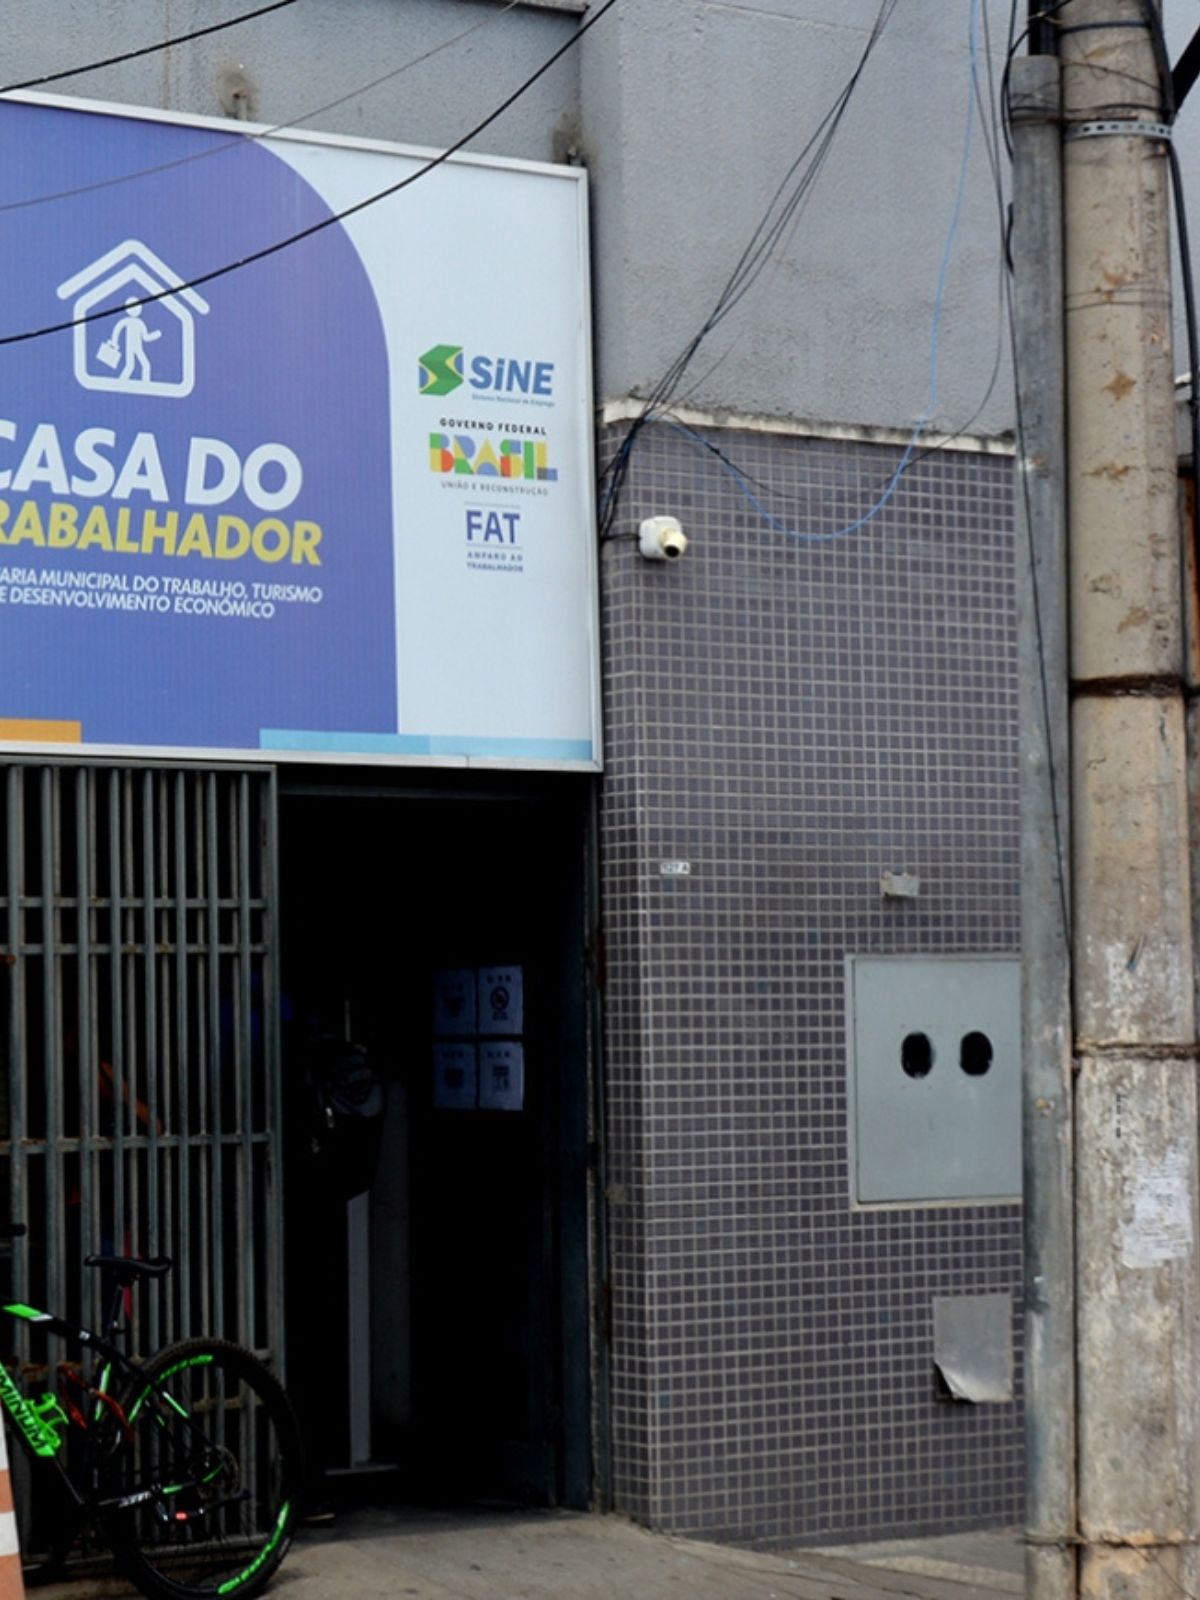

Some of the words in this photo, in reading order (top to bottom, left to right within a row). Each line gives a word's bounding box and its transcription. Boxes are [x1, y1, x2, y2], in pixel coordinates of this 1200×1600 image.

[440, 417, 494, 431] GOVERNO
[498, 422, 547, 436] FEDERAL
[184, 436, 303, 511] DO
[429, 432, 558, 482] BRASIL
[466, 509, 521, 545] FAT
[10, 587, 170, 612] DESENVOLVIMENTO
[39, 569, 129, 591] MUNICIPAL
[133, 574, 160, 593] DO
[162, 576, 248, 600] TRABALHO,
[252, 582, 323, 603] TURISMO
